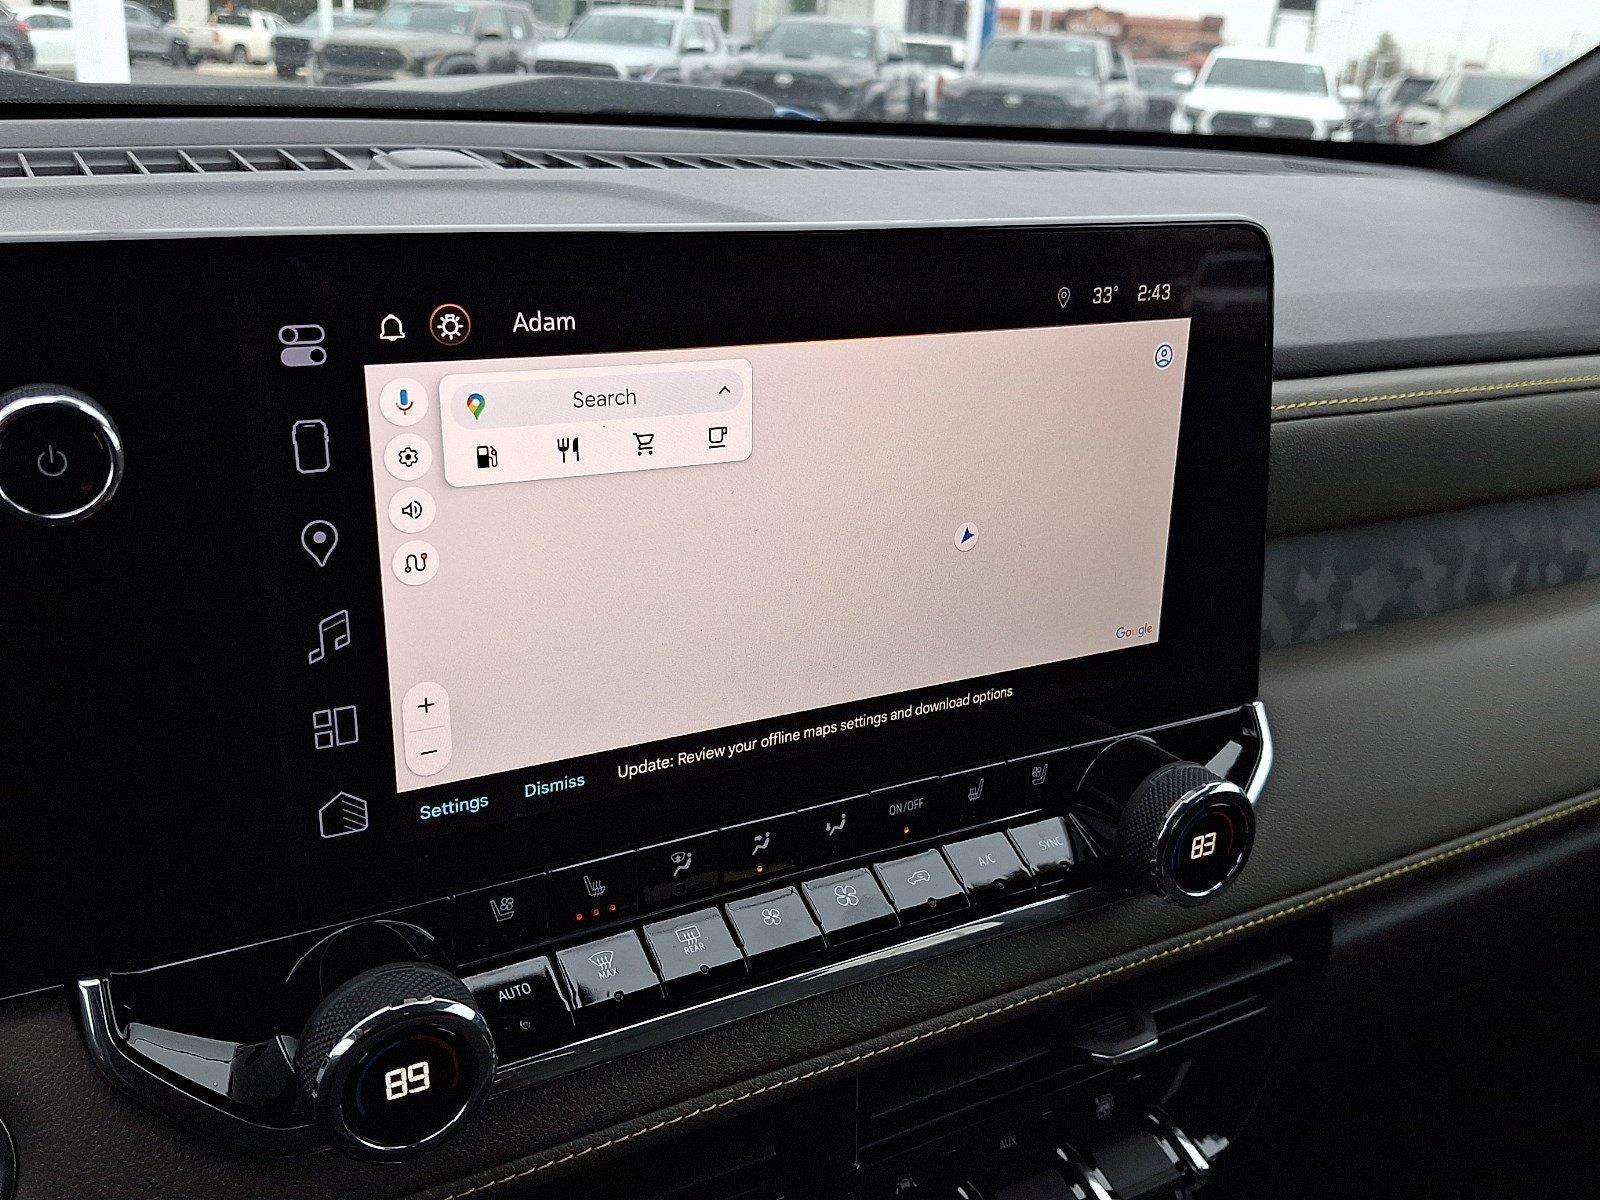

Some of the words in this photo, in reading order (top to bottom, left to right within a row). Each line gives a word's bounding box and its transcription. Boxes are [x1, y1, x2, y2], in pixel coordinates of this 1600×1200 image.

[1092, 284, 1119, 305] 33°
[1136, 283, 1172, 303] 2:43
[513, 310, 576, 333] Adam
[572, 389, 637, 409] Search
[1115, 622, 1153, 640] Google
[617, 757, 675, 780] Update:
[677, 745, 726, 767] Review
[726, 740, 758, 760] your
[760, 730, 800, 748] offline
[803, 724, 838, 742] maps
[839, 713, 888, 732] settings
[890, 708, 912, 722] and
[914, 694, 970, 716] download
[971, 688, 1014, 706] options
[523, 774, 586, 799] Dismiss
[419, 795, 490, 821] Settings
[888, 797, 925, 817] ON/OFF
[1037, 835, 1064, 852] SYNC
[1190, 832, 1218, 860] 83
[978, 853, 996, 868] A/C
[683, 941, 706, 955] REAR
[597, 966, 620, 981] MAX
[497, 982, 532, 1003] AUTO
[384, 1060, 431, 1101] 89
